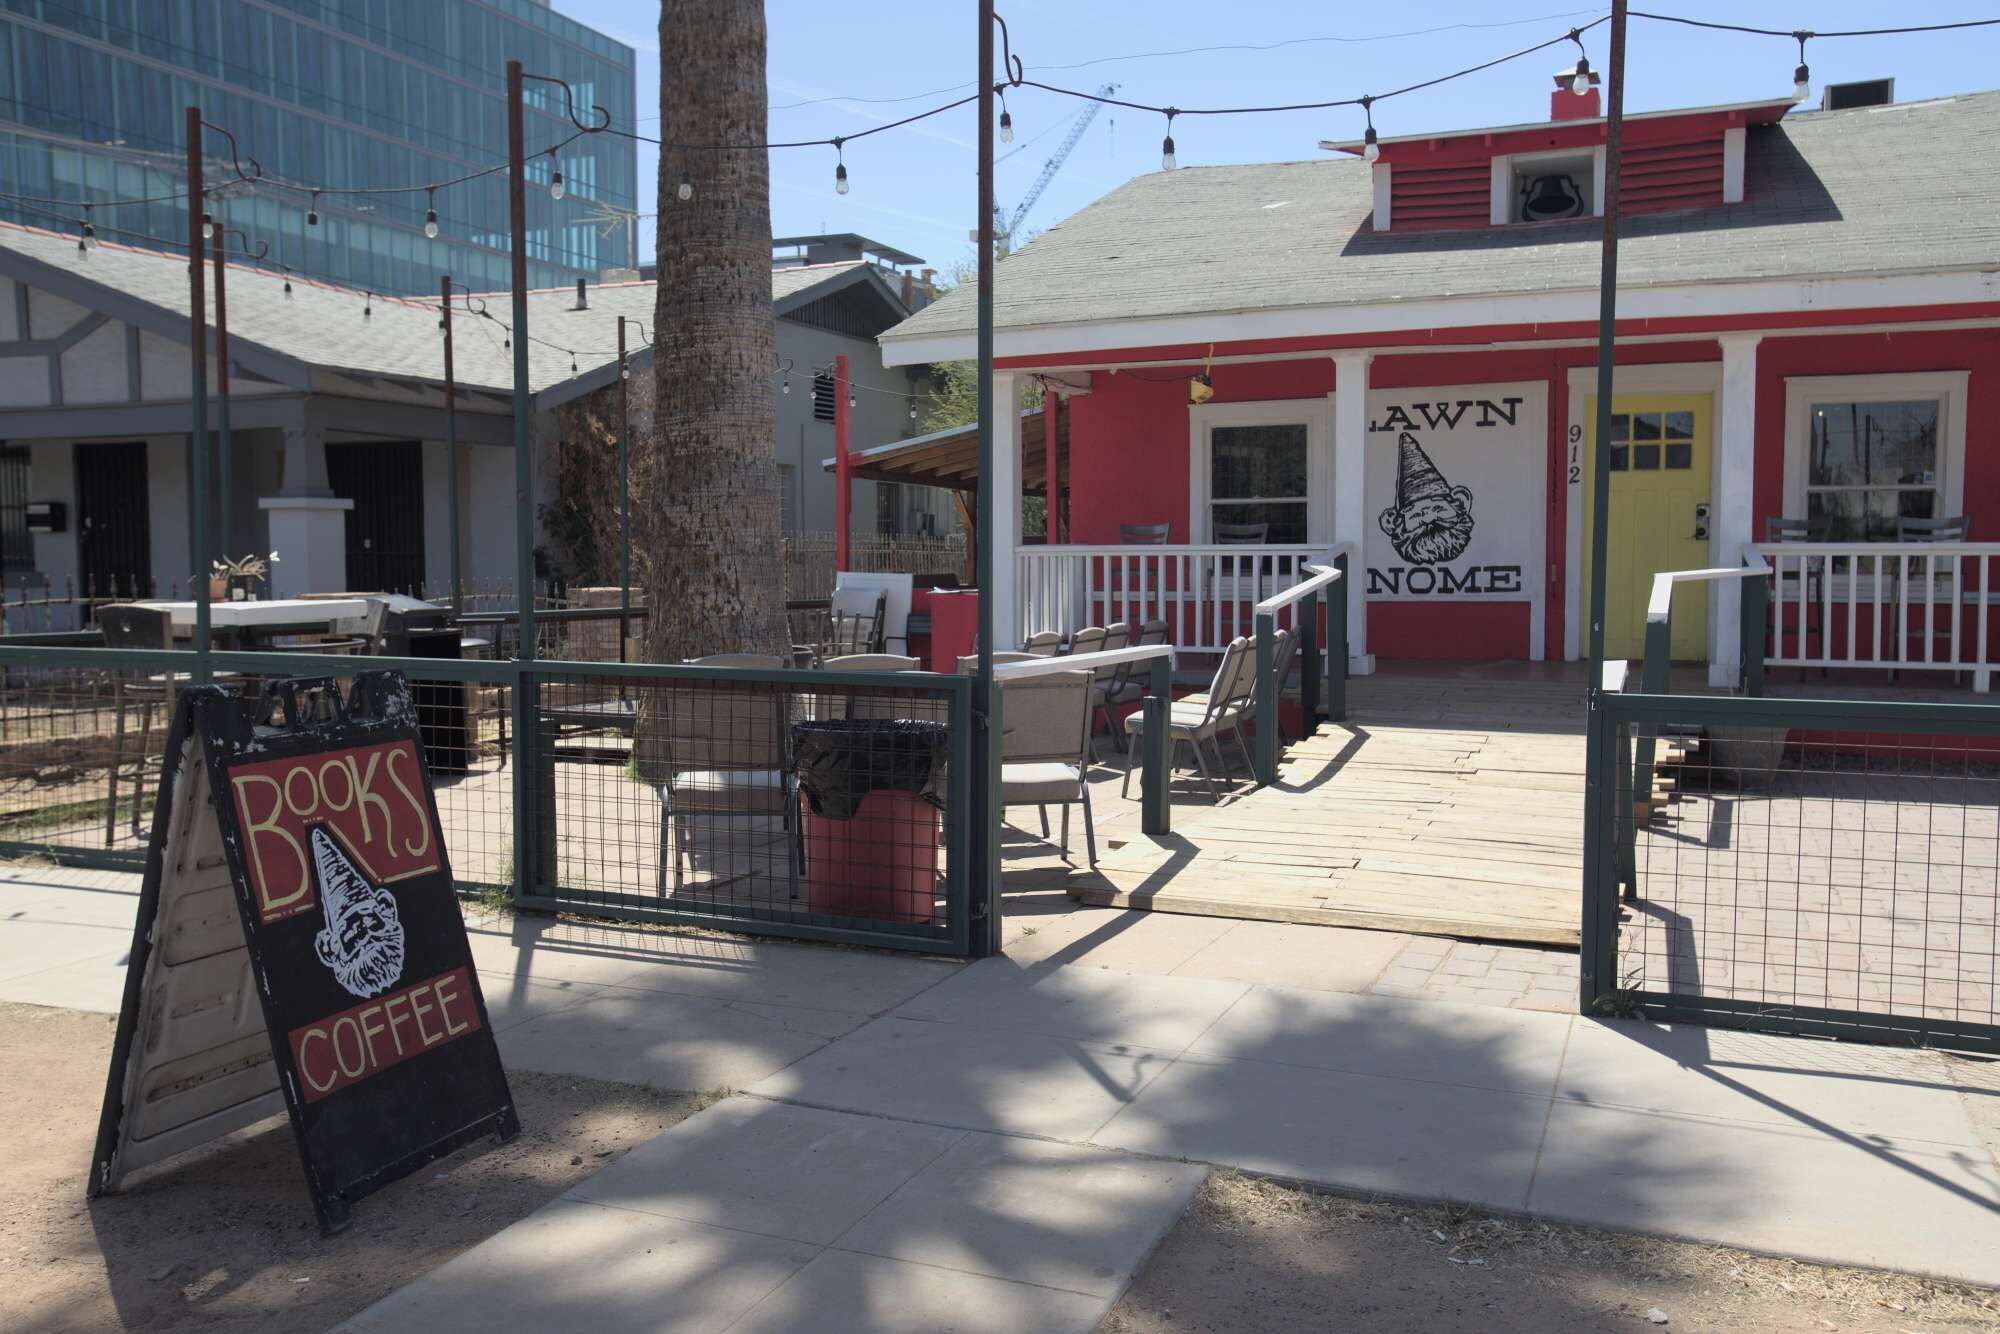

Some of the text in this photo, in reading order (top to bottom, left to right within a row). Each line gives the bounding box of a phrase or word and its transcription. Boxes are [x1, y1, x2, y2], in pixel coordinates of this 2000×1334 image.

[1568, 425, 1582, 484] 912
[233, 749, 429, 910] BOOKS
[300, 976, 468, 1092] COFFEE
